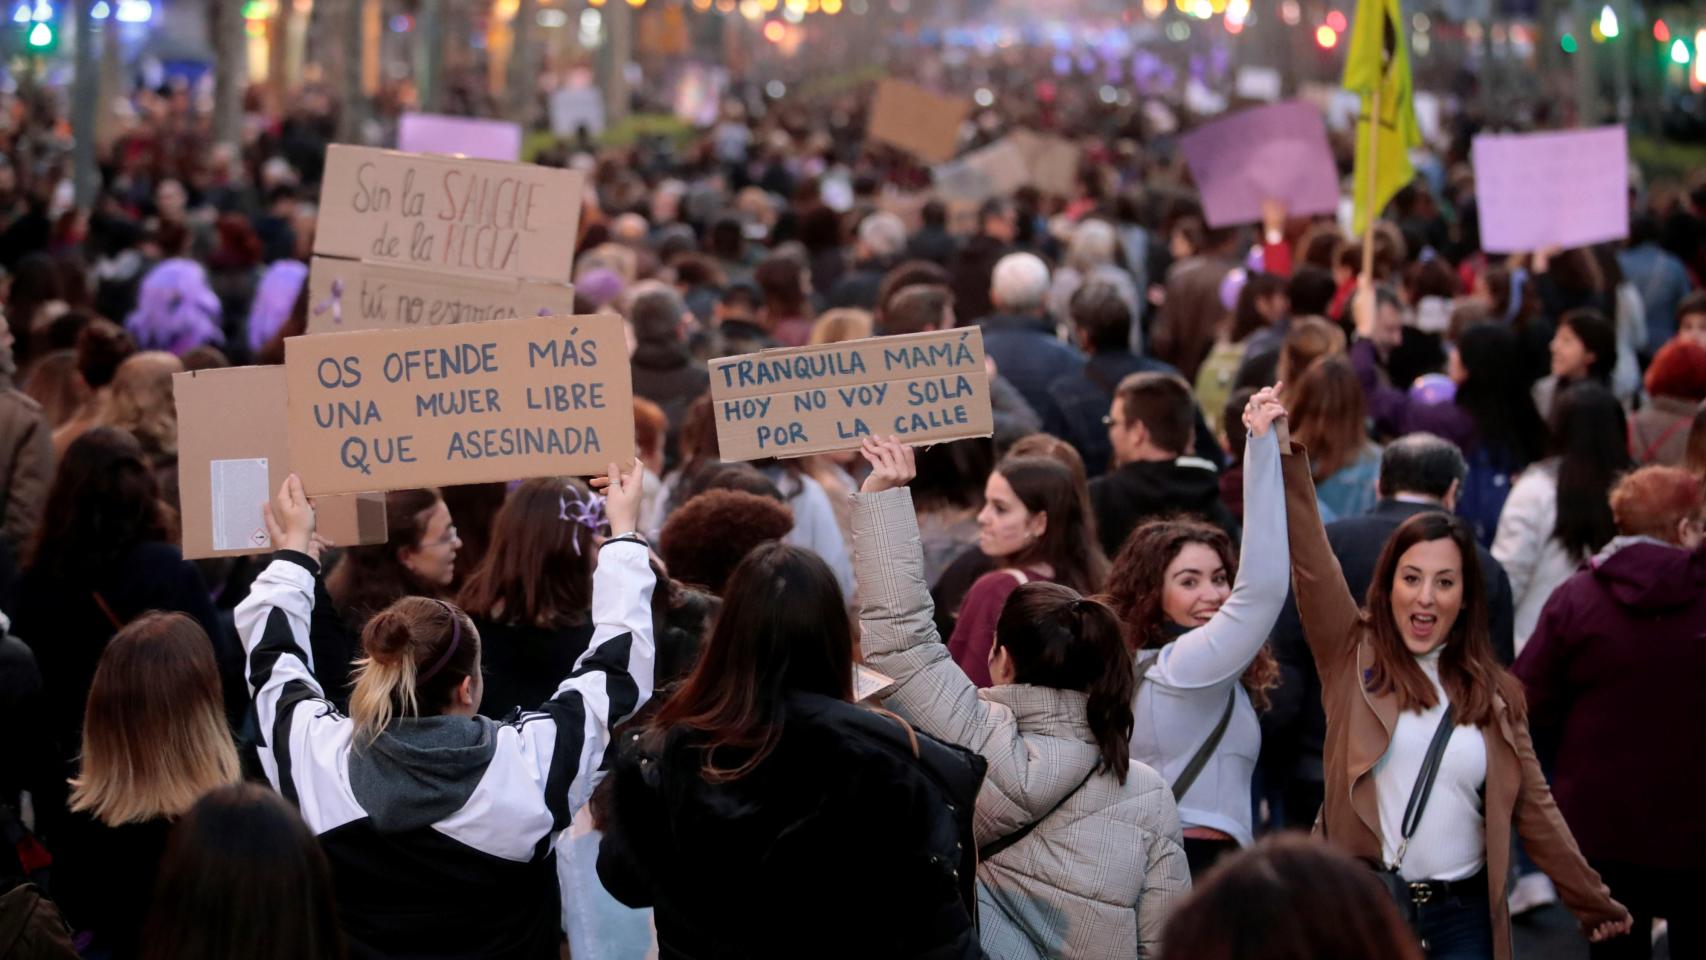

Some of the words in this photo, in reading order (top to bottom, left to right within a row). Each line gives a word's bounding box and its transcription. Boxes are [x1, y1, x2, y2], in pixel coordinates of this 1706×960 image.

[352, 161, 391, 214] Sin
[402, 167, 425, 218] la
[372, 220, 399, 257] de
[410, 221, 434, 261] la
[360, 280, 387, 320] tú
[398, 294, 424, 325] no
[317, 356, 362, 389] OS
[383, 342, 499, 383] OFENDE
[528, 326, 598, 368] MÁS
[717, 351, 867, 388] TRANQUILA
[884, 331, 976, 371] MAMÁ
[313, 400, 382, 429] UNA
[416, 388, 502, 417] MUJER
[526, 382, 606, 412] LIBRE
[723, 396, 772, 422] HOY
[794, 389, 827, 412] NO
[838, 382, 888, 408] VOY
[907, 375, 973, 406] SOLA
[757, 421, 808, 449] POR
[836, 418, 871, 440] LA
[894, 404, 969, 434] CALLE
[340, 435, 418, 475] QUE
[447, 426, 601, 461] ASESINADA
